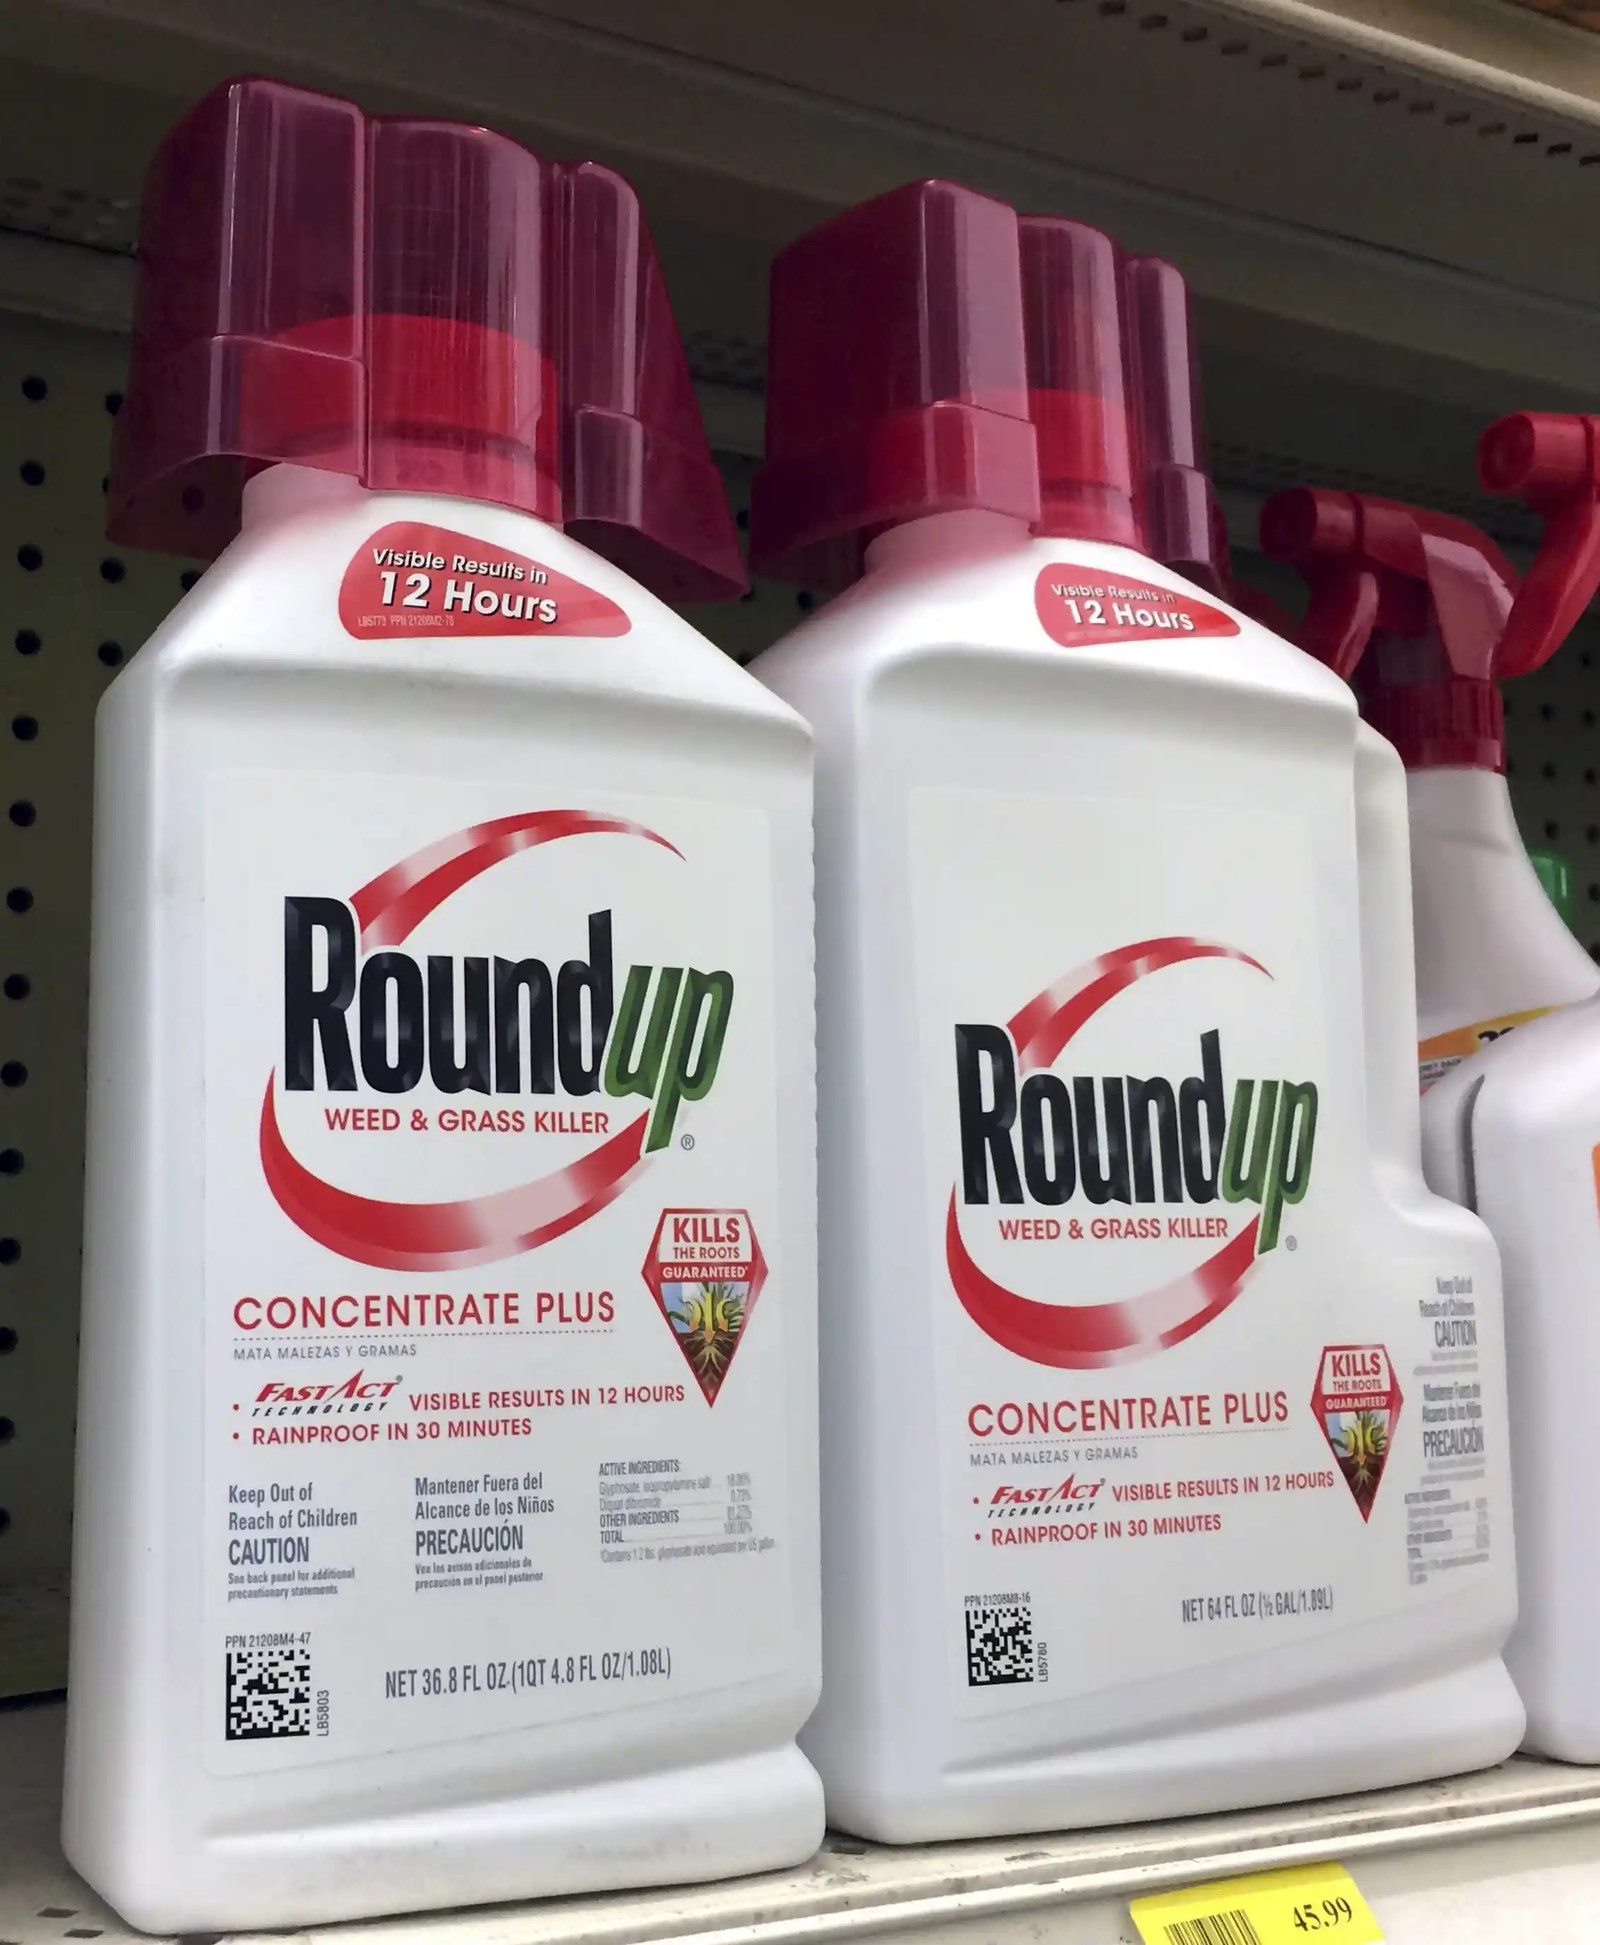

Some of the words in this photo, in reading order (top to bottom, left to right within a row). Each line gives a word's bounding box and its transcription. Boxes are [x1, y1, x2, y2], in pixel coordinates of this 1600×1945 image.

[373, 548, 445, 570] Visible
[452, 554, 525, 580] Results
[530, 566, 548, 585] in
[380, 571, 431, 608] 12
[444, 579, 557, 624] Hours
[1051, 584, 1105, 597] Visible
[1108, 586, 1160, 601] Results
[1163, 593, 1176, 604] in
[1064, 600, 1107, 625] 12
[1112, 602, 1195, 632] Hours
[284, 896, 734, 1153] Roundup
[325, 1108, 400, 1131] WEED
[410, 1109, 428, 1130] &
[437, 1109, 525, 1132] GRASS
[534, 1111, 608, 1134] KILLER
[955, 1024, 1318, 1254] Roundup
[674, 1218, 740, 1243] KILLS
[999, 1219, 1060, 1240] WEED
[1069, 1219, 1084, 1238] &
[1091, 1218, 1161, 1238] GRASS
[1168, 1218, 1228, 1237] KILLER
[674, 1247, 695, 1259] THE
[700, 1247, 740, 1259] ROOTS
[234, 1293, 519, 1330] CONCENTRATE
[537, 1291, 614, 1323] PLUS
[1435, 1320, 1477, 1348] CAUTION
[234, 1347, 271, 1360] MATA
[278, 1346, 340, 1359] MALEZAS
[345, 1346, 353, 1357] Y
[359, 1344, 416, 1358] GRAMAS
[1332, 1353, 1381, 1377] KILLS
[1333, 1381, 1348, 1391] THE
[1352, 1379, 1382, 1390] ROOTS
[252, 1402, 387, 1417] TECHNOLOGY
[410, 1391, 480, 1411] VISIBLE
[489, 1389, 563, 1407] RESULTS
[571, 1389, 589, 1405] IN
[598, 1388, 618, 1404] 12
[625, 1385, 684, 1402] HOURS
[969, 1395, 1210, 1437] CONCENTRATE
[1225, 1392, 1288, 1423] PLUS
[253, 1425, 379, 1444] RAINPROOF
[388, 1423, 407, 1440] IN
[417, 1421, 440, 1439] 30
[449, 1419, 531, 1437] MINUTES
[1423, 1420, 1484, 1458] PRECAUCIÓN
[599, 1462, 626, 1476] ACTIVE
[971, 1453, 1006, 1467] MATA
[1012, 1451, 1069, 1464] MALEZAS
[1074, 1450, 1080, 1461] Y
[1085, 1447, 1138, 1461] GRAMAS
[229, 1485, 265, 1507] Keep
[271, 1483, 294, 1502] Out
[300, 1482, 312, 1500] of
[415, 1478, 479, 1495] Mantener
[484, 1474, 518, 1492] Fuera
[524, 1472, 542, 1490] del
[1112, 1484, 1171, 1502] VISIBLE
[1178, 1478, 1238, 1498] RESULTS
[1244, 1477, 1259, 1493] IN
[1265, 1476, 1280, 1492] 12
[1285, 1471, 1334, 1489] HOURS
[229, 1511, 274, 1530] Reach
[280, 1510, 292, 1528] of
[298, 1508, 357, 1527] Children
[415, 1502, 470, 1520] Alcance
[475, 1499, 490, 1516] de
[495, 1498, 513, 1515] los
[518, 1496, 554, 1514] Niños
[600, 1514, 626, 1528] OTHER
[629, 1510, 679, 1525] INGREDIENTS
[988, 1502, 1095, 1518] TECHNOLOGY
[416, 1519, 523, 1556] PRECAUCIÓN
[600, 1531, 624, 1544] TOTAL
[992, 1523, 1098, 1546] RAINPROOF
[1105, 1522, 1121, 1538] IN
[1128, 1520, 1148, 1537] 30
[1153, 1514, 1221, 1535] MINUTES
[229, 1537, 309, 1565] CAUTION
[228, 1573, 244, 1584] See
[247, 1572, 268, 1583] back
[271, 1571, 295, 1585] panel
[298, 1570, 308, 1581] for
[312, 1568, 354, 1580] additional
[433, 1563, 445, 1573] los
[448, 1562, 472, 1573] avisos
[523, 1557, 532, 1568] de
[463, 1577, 473, 1586] en
[475, 1574, 482, 1585] el
[485, 1574, 506, 1587] panel
[509, 1572, 543, 1585] posterior
[228, 1588, 289, 1601] precautionary
[291, 1584, 338, 1596] statements
[964, 1596, 981, 1606] PPN
[1182, 1598, 1204, 1623] NET
[1208, 1597, 1221, 1620] 64
[1225, 1596, 1238, 1618] FL
[1241, 1593, 1255, 1617] OZ
[226, 1636, 246, 1648] PPN
[249, 1632, 311, 1647] 21208M4-47
[386, 1669, 417, 1698] NET
[423, 1668, 458, 1696] 36.8
[464, 1665, 480, 1692] FL
[552, 1657, 574, 1684] 4.8
[580, 1655, 596, 1681] FL
[602, 1647, 670, 1681] OZ/1.08L)
[1037, 1642, 1048, 1682] LB5780
[317, 1690, 329, 1736] LB5803
[1294, 1896, 1352, 1932] 45.99
